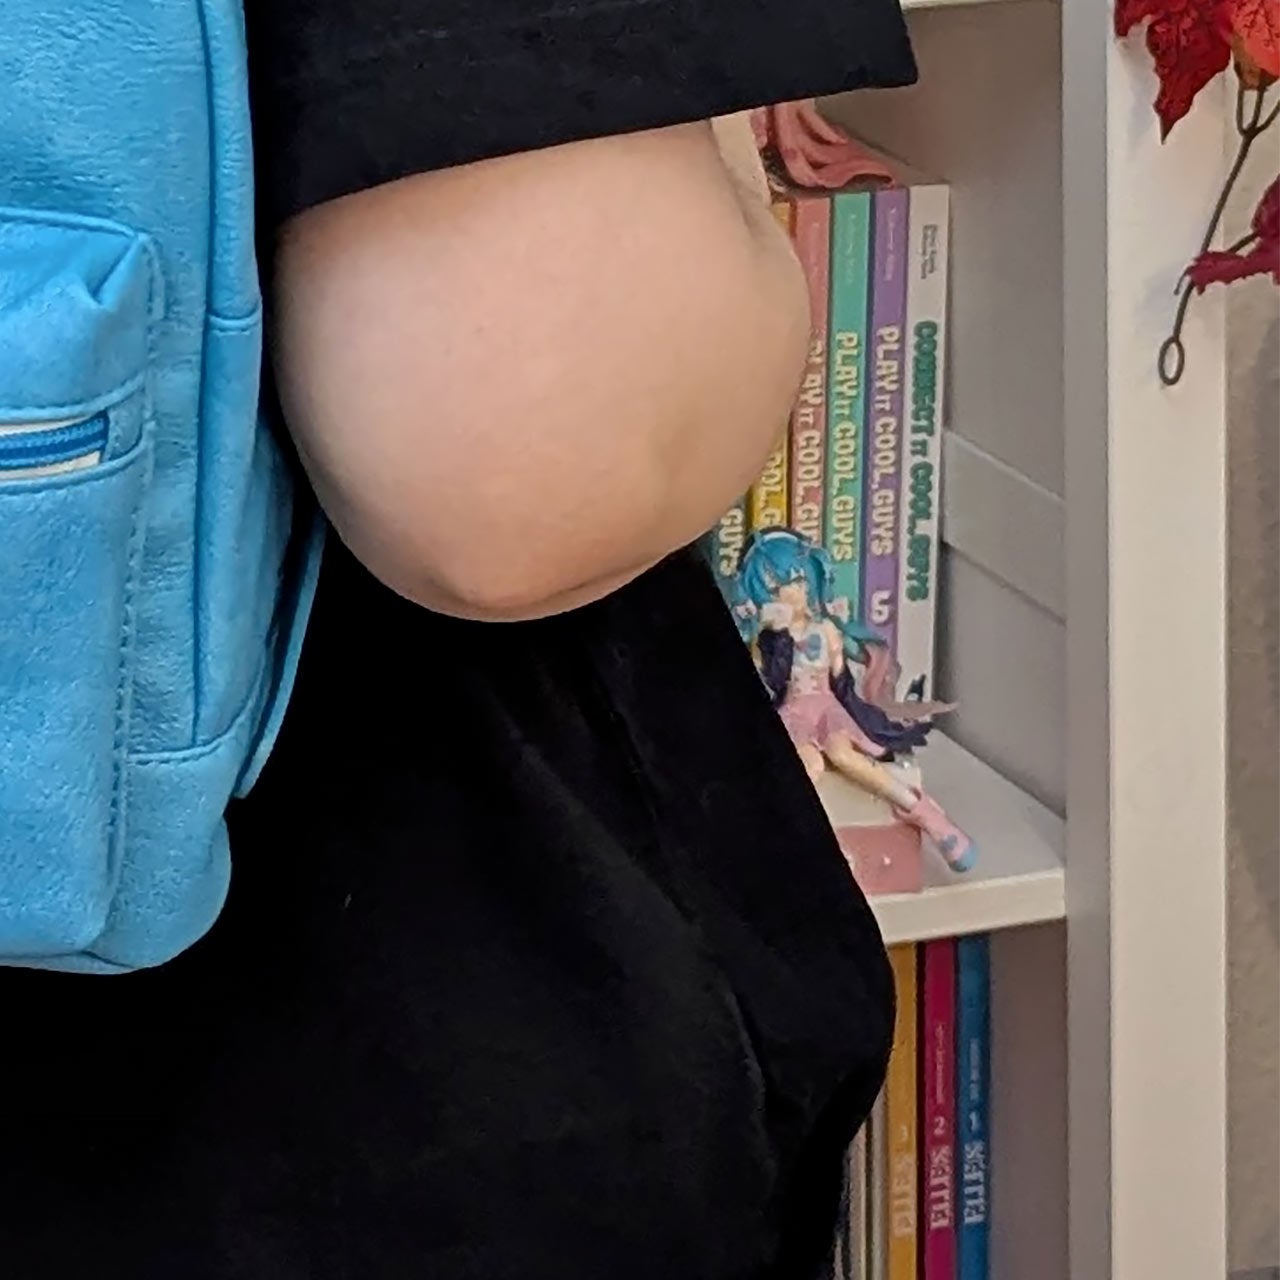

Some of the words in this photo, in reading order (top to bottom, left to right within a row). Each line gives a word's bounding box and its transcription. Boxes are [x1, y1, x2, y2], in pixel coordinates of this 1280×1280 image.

[834, 331, 858, 399] PLAY
[876, 325, 901, 395] PLAY
[911, 320, 938, 437] CONNECT
[798, 407, 816, 428] IT
[833, 399, 850, 417] IT
[874, 394, 891, 413] IT
[833, 494, 854, 561] GUYS
[870, 488, 895, 556] GUYS
[905, 534, 931, 602] GUYS
[934, 1116, 946, 1137] 2
[969, 1111, 980, 1132] 1
[929, 1144, 951, 1229] ELLES
[964, 1140, 986, 1224] ELLES
